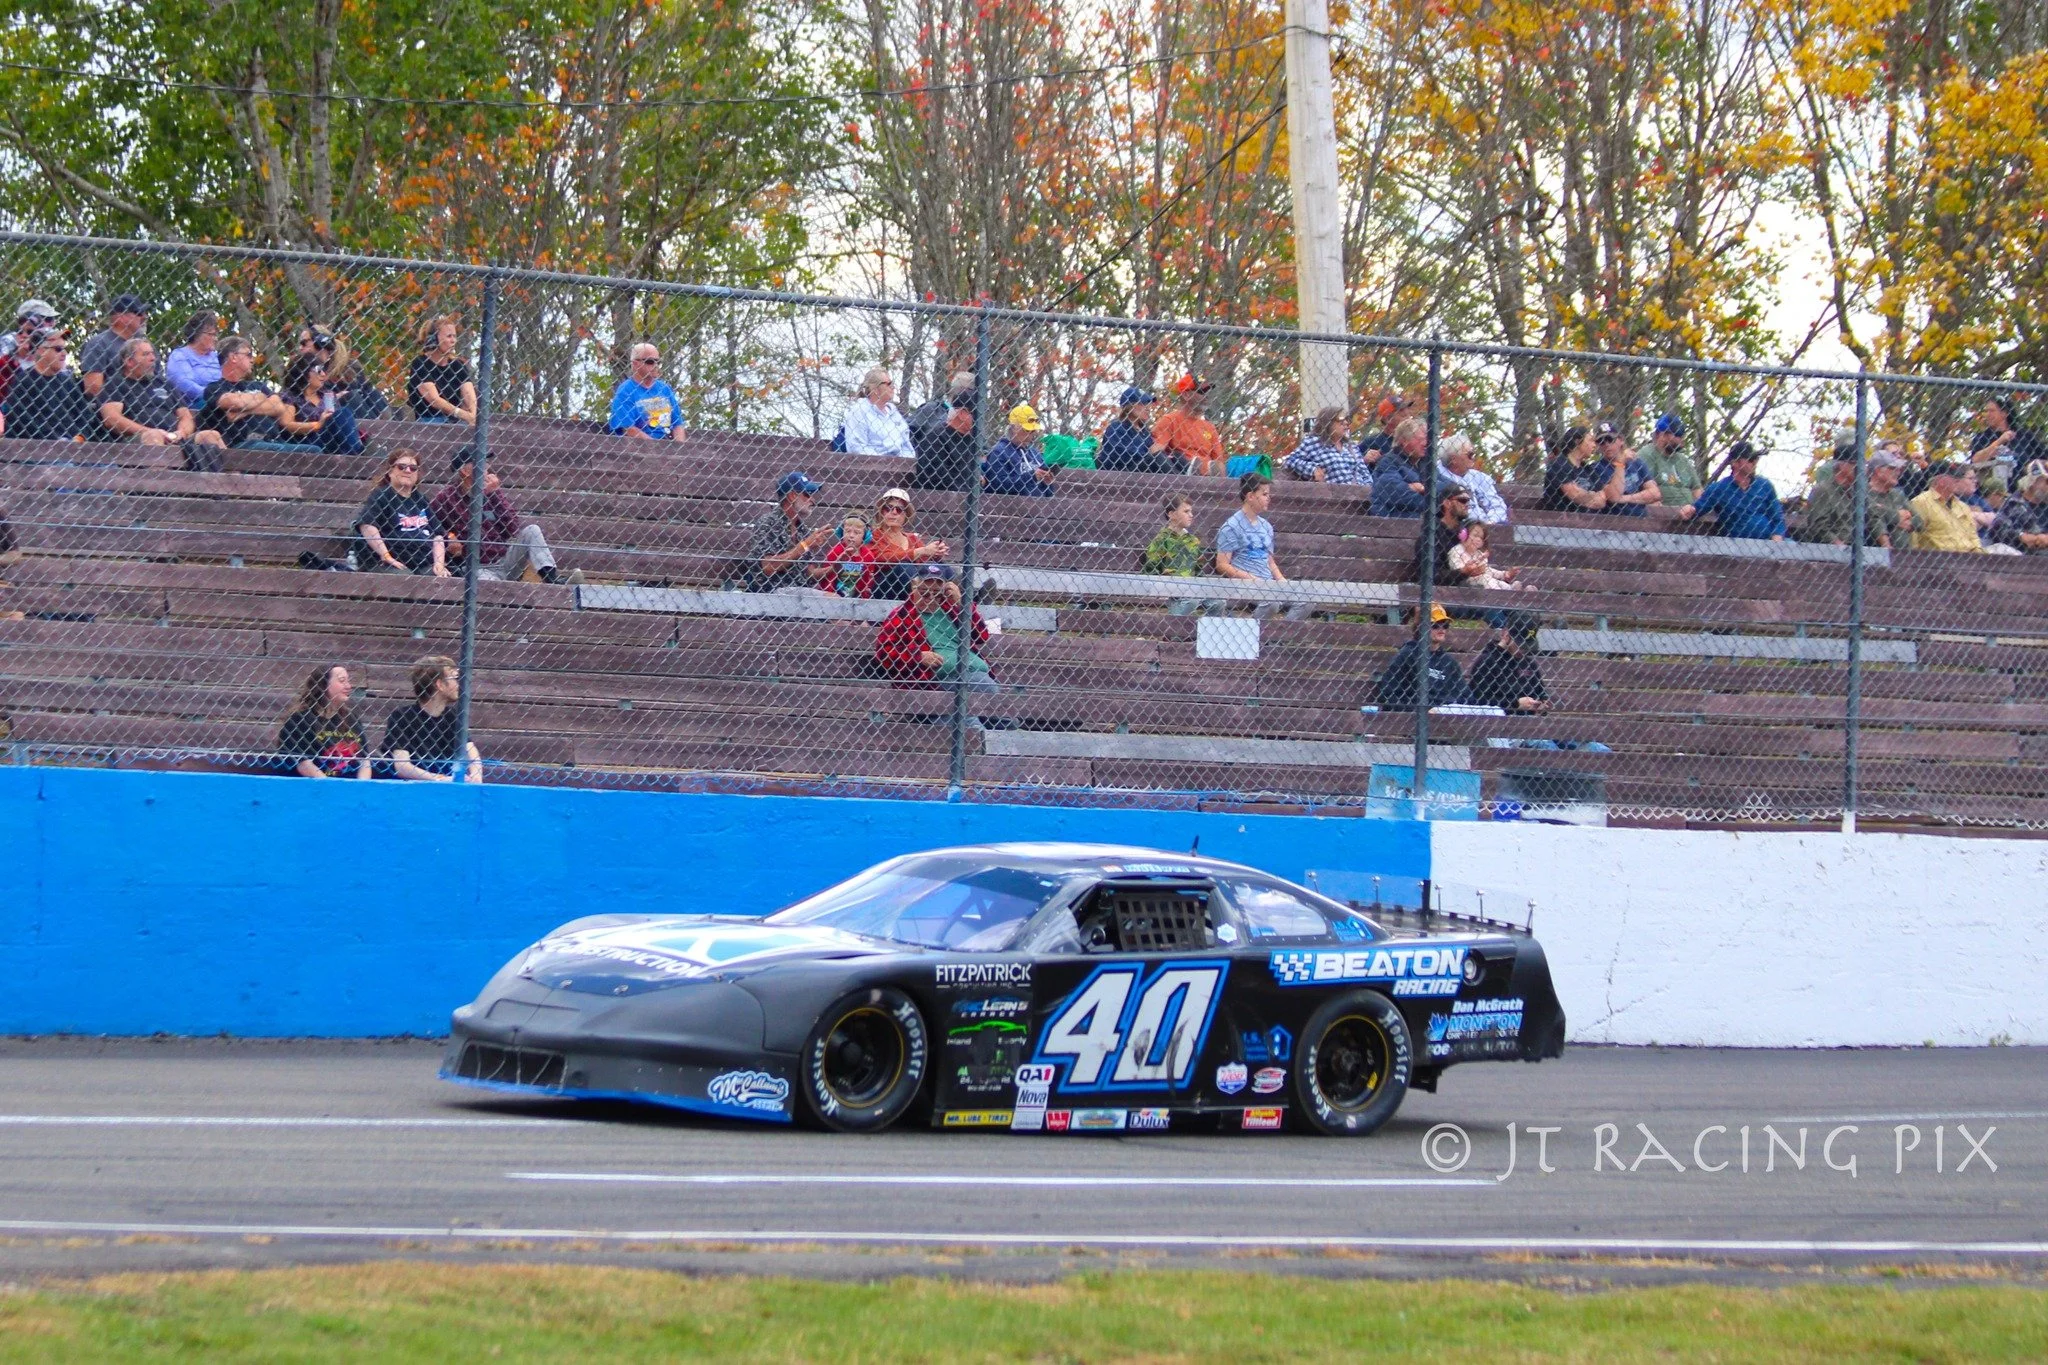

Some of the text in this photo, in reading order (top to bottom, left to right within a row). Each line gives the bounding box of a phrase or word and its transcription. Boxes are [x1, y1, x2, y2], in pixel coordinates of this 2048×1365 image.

[935, 962, 1032, 983] FITZPATRICK
[1313, 948, 1465, 980] BEATON
[1393, 979, 1460, 997] RACING
[1452, 998, 1524, 1013] Dan McGrath
[1042, 968, 1221, 1085] 40
[893, 1001, 923, 1080] Hoosier
[1019, 1068, 1052, 1083] QA1
[1019, 1089, 1047, 1104] Nova
[1130, 1112, 1170, 1129] Dulux
